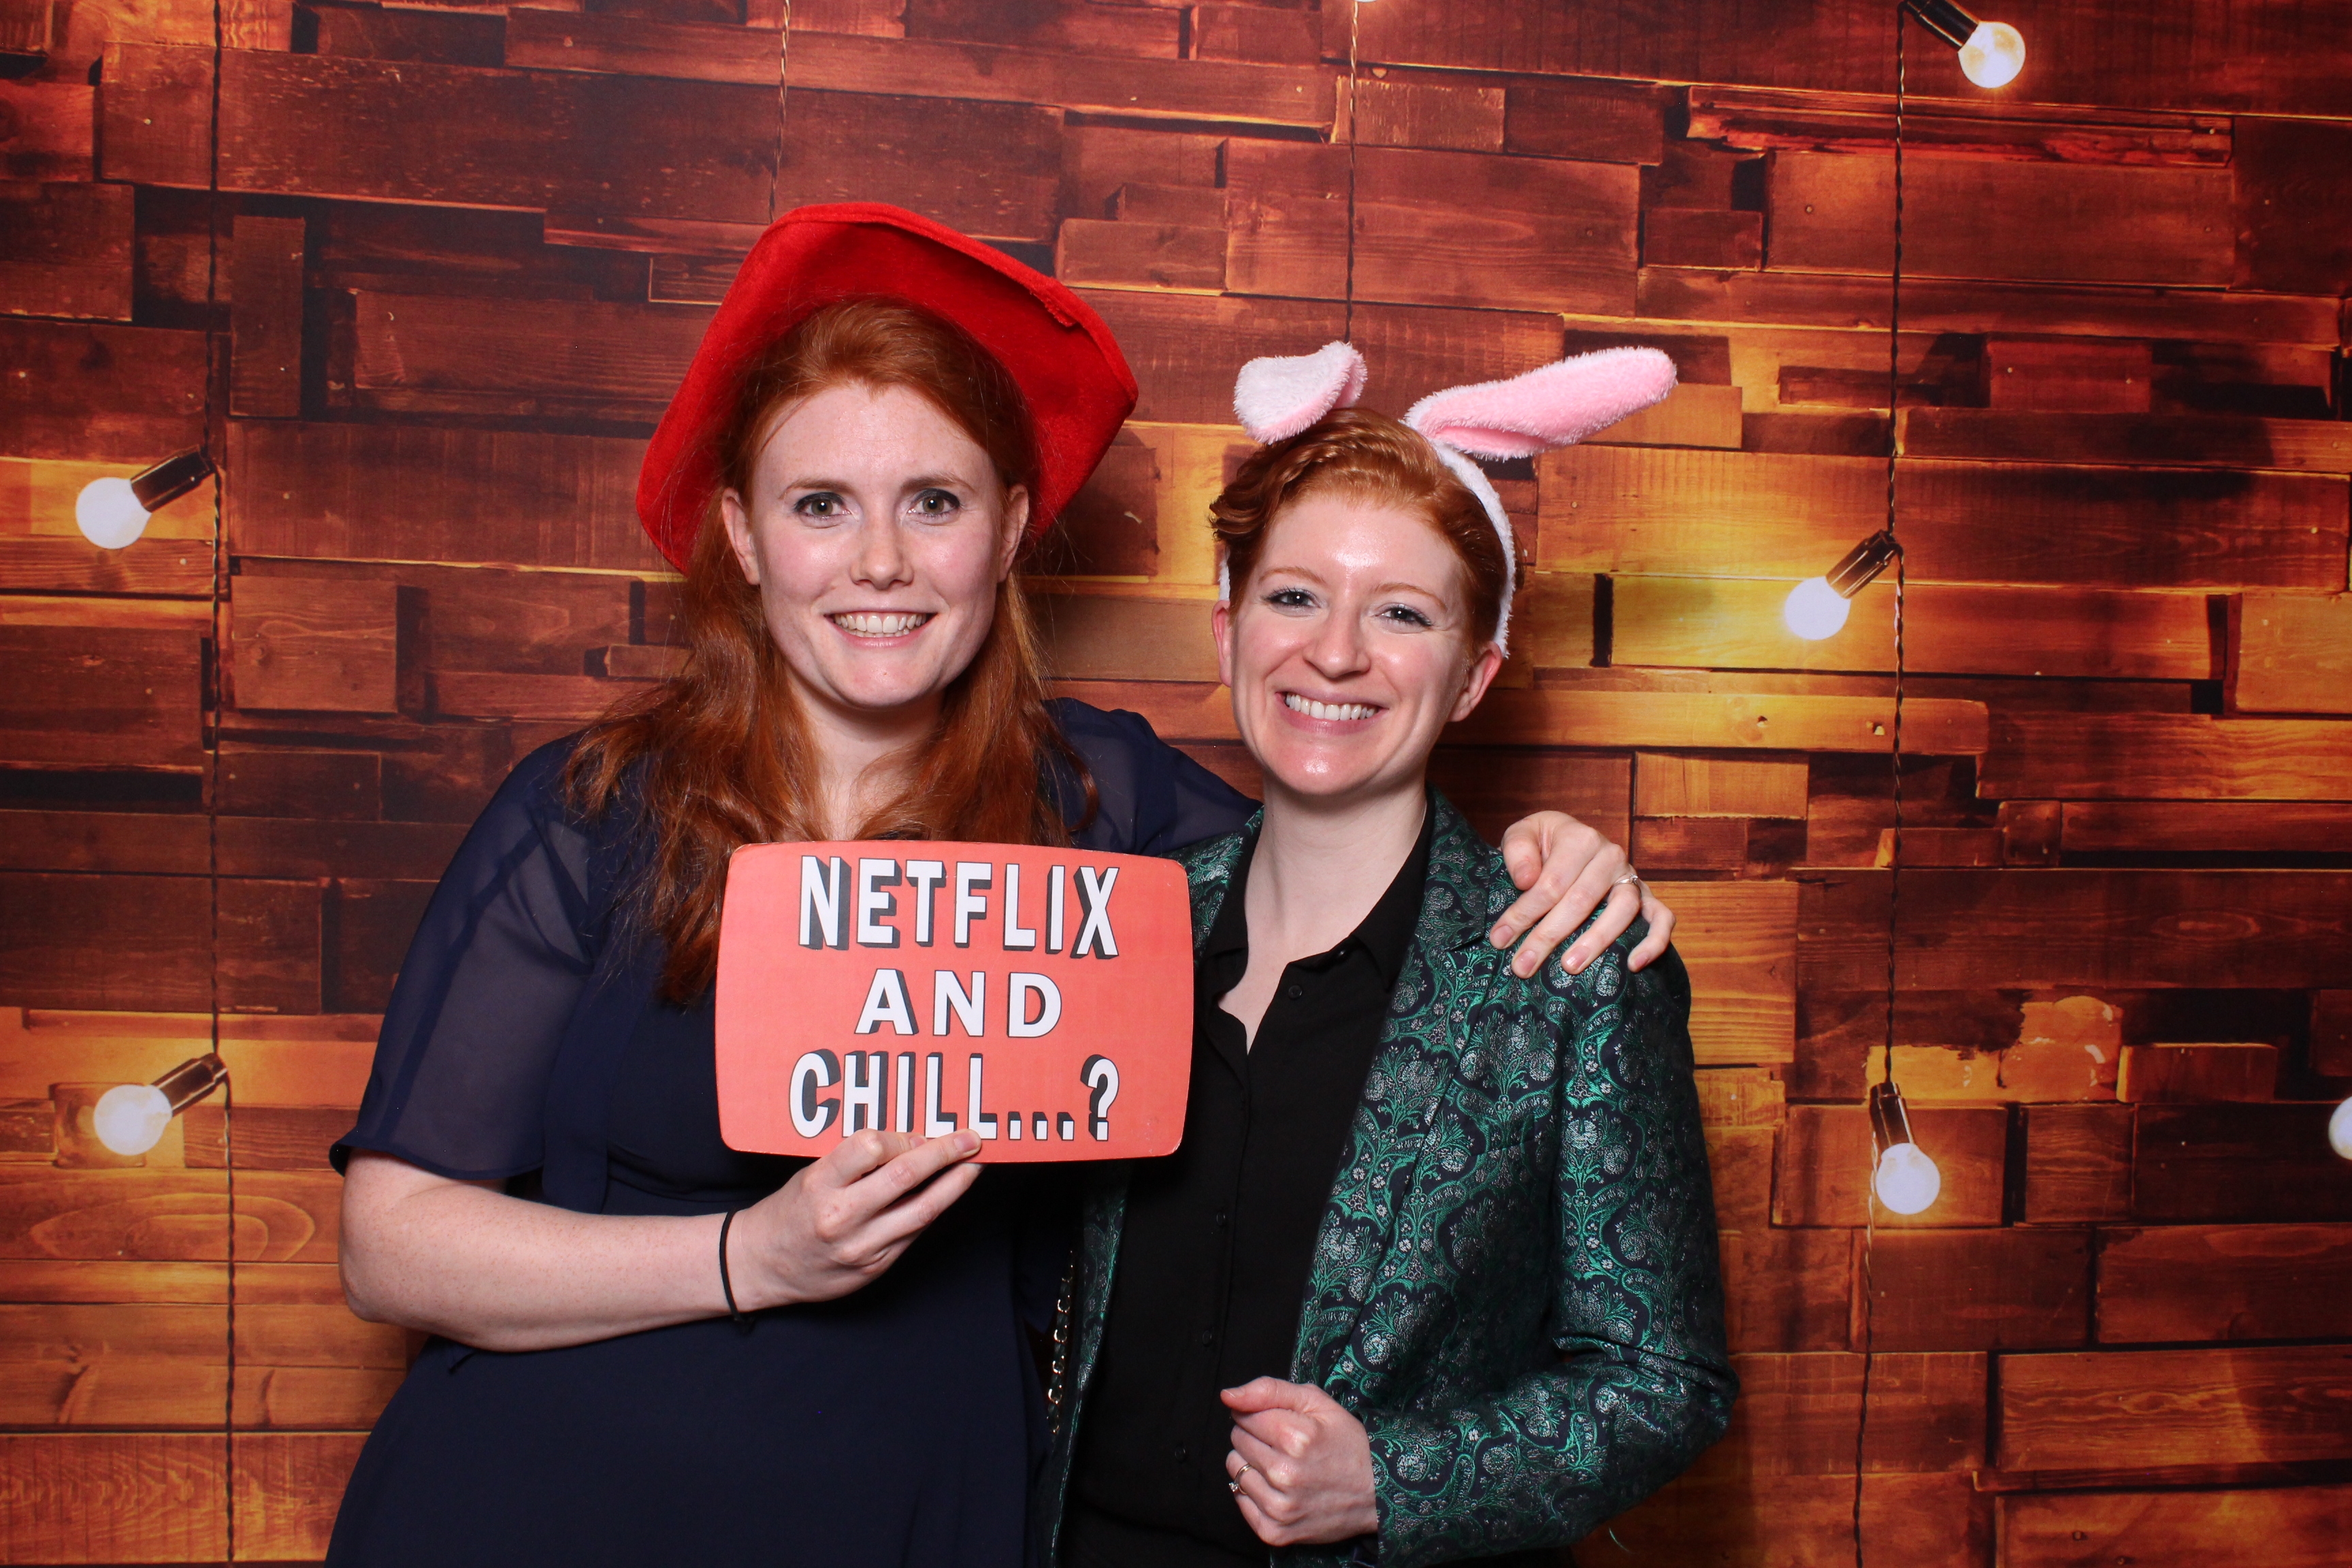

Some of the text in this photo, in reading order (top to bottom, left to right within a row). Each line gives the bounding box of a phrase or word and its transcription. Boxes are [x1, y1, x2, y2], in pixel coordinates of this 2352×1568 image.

[798, 855, 1120, 959] NETFLIX
[854, 968, 1062, 1038] AND
[789, 1049, 1120, 1141] CHILL...?
